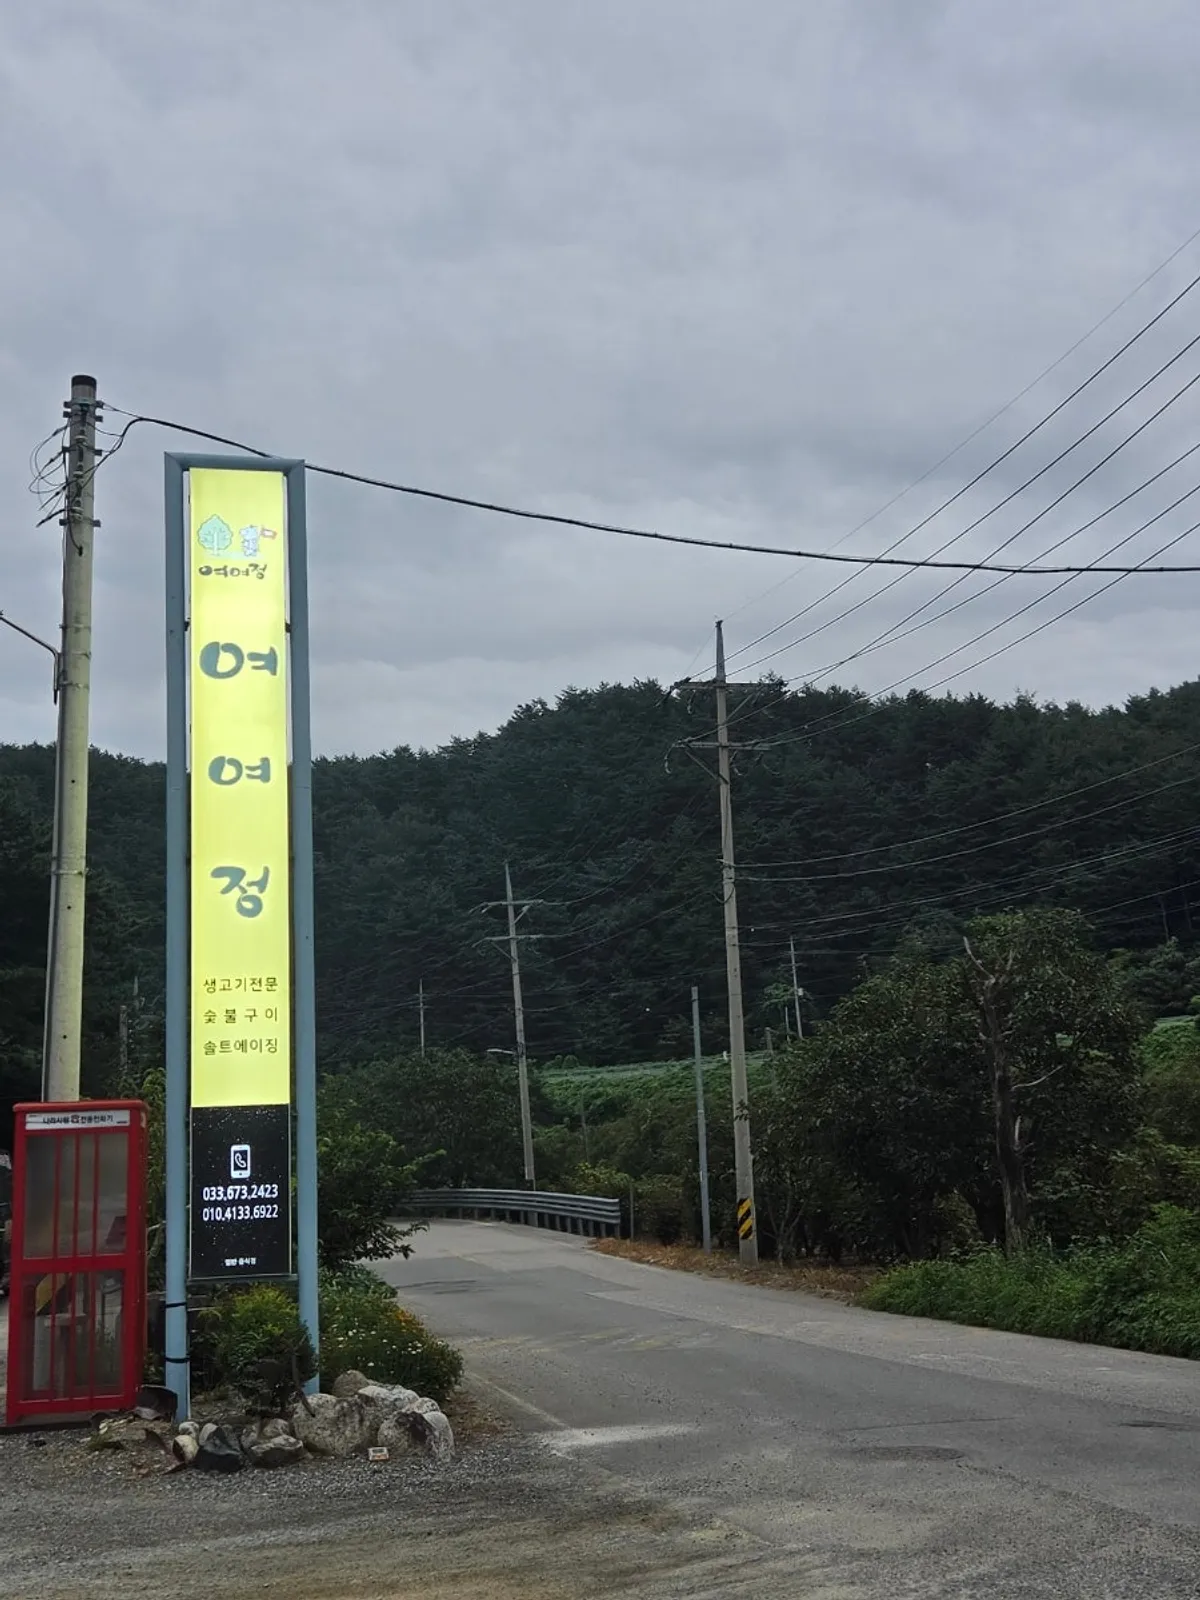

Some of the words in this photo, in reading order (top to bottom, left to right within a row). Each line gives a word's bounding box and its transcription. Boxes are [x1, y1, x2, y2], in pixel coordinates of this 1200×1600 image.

[198, 562, 268, 580] 여여정
[203, 977, 278, 994] 생고기전문
[203, 1038, 278, 1056] 솔트에이징
[202, 1184, 279, 1201] 033.673.2423
[202, 1204, 279, 1222] 010.4133.6922
